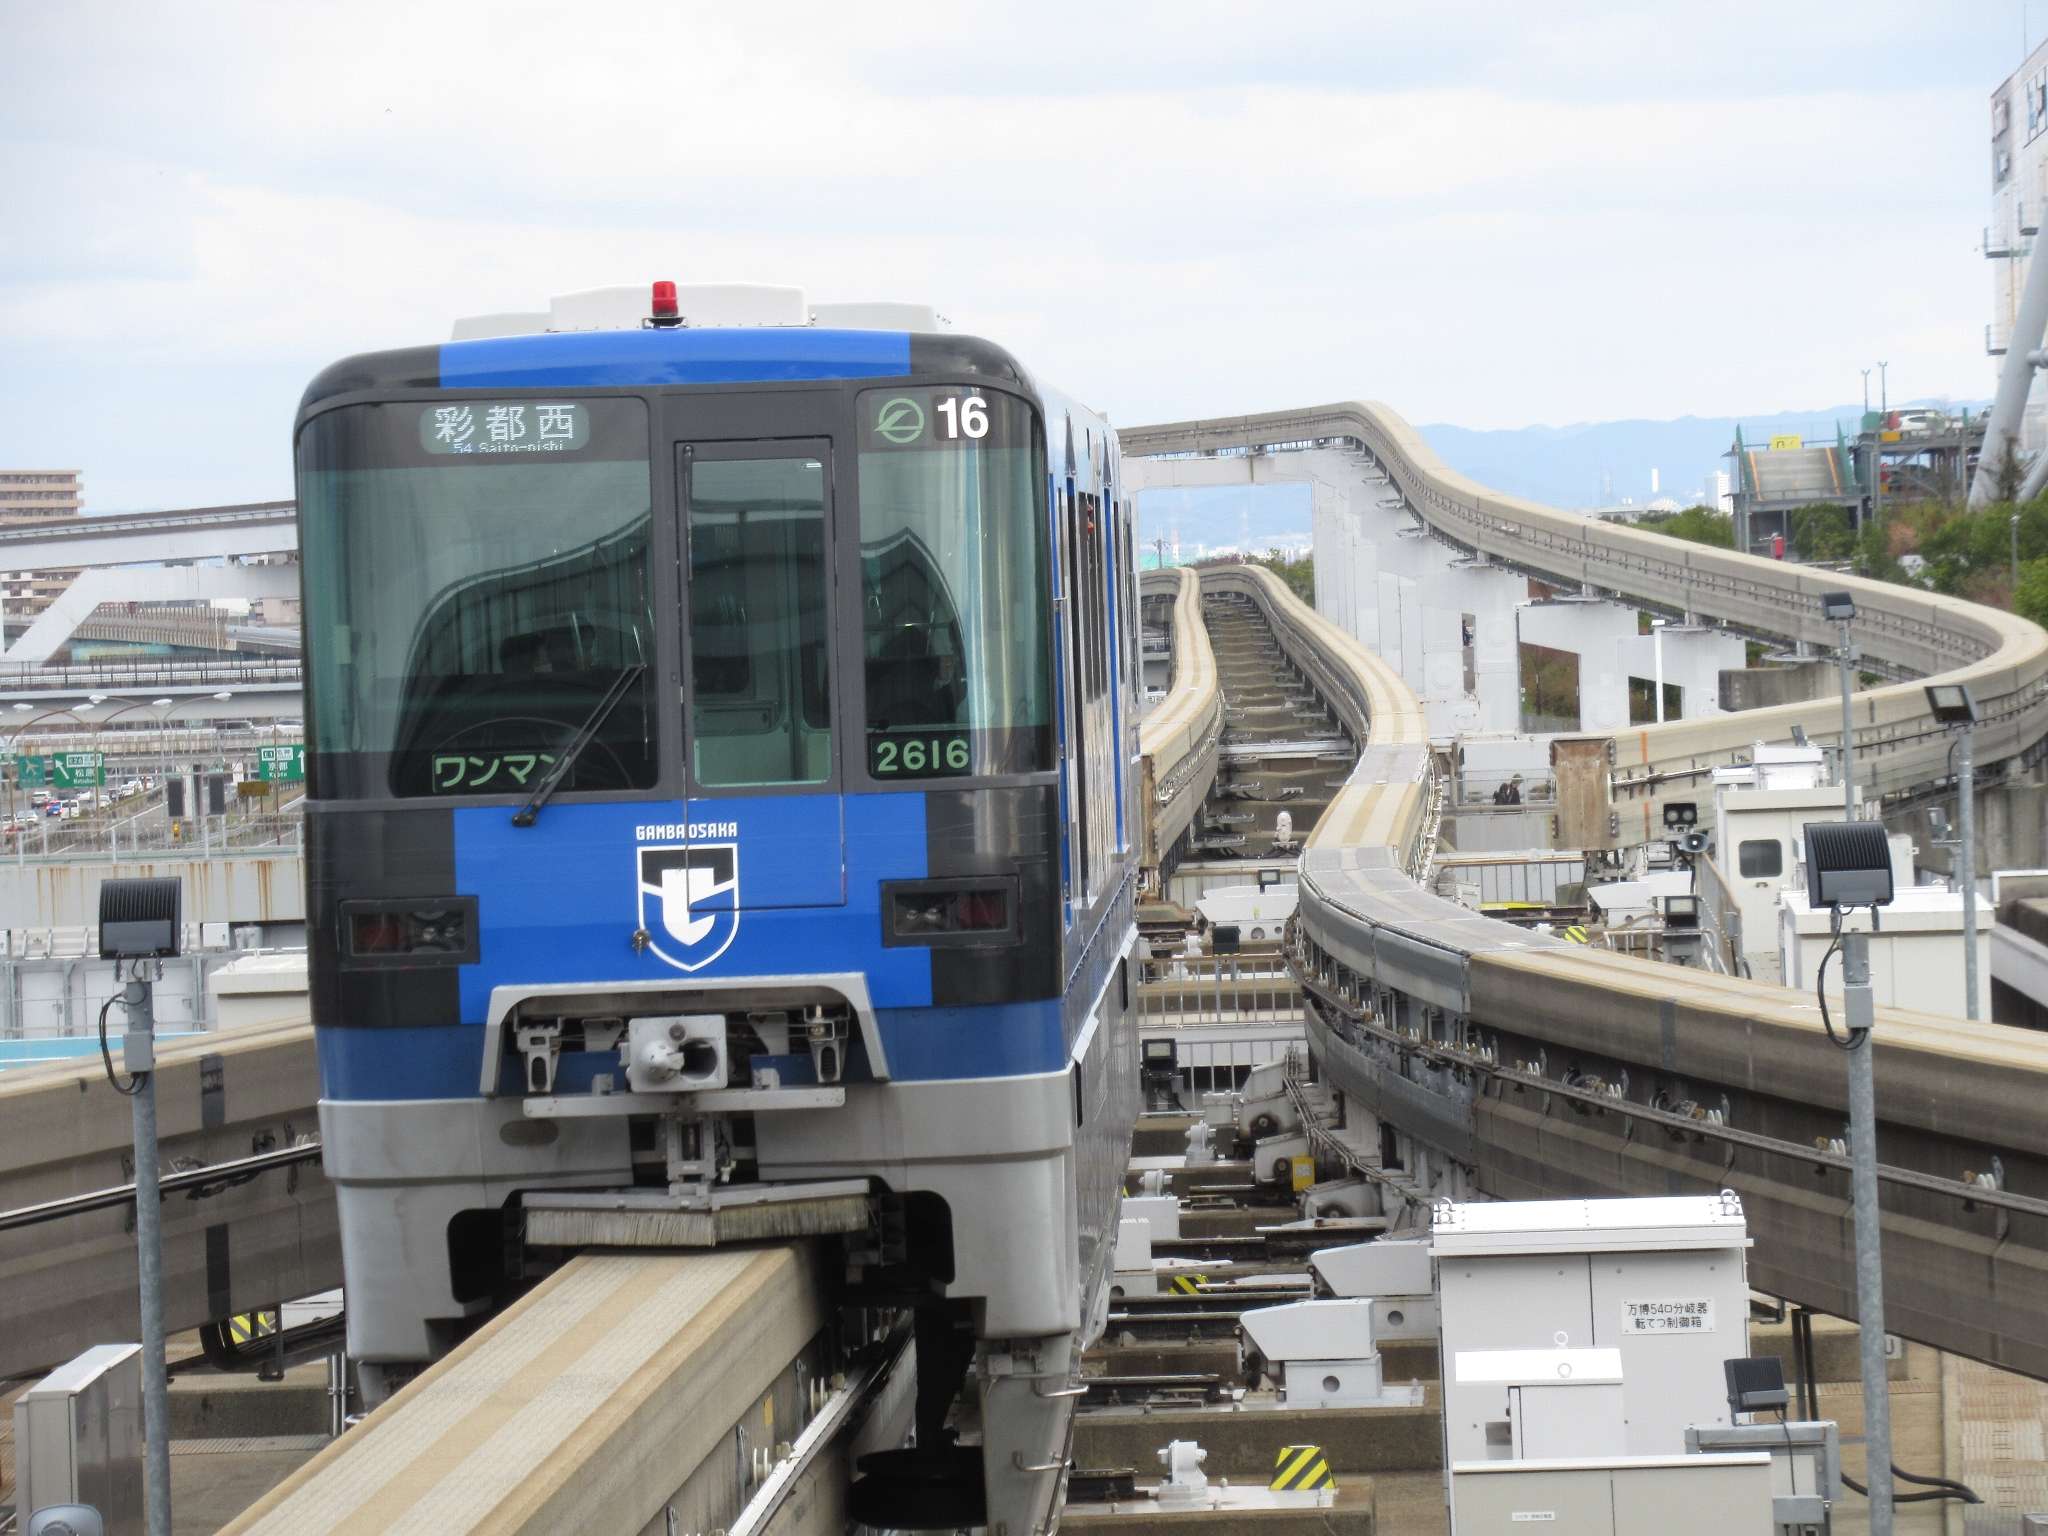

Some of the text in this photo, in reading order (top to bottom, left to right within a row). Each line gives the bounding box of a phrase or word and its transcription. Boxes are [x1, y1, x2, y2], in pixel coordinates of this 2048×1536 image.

[434, 404, 577, 443] 彩都西
[937, 396, 989, 439] 16
[877, 739, 969, 771] 2616
[635, 821, 738, 841] GAMBA OSAKA
